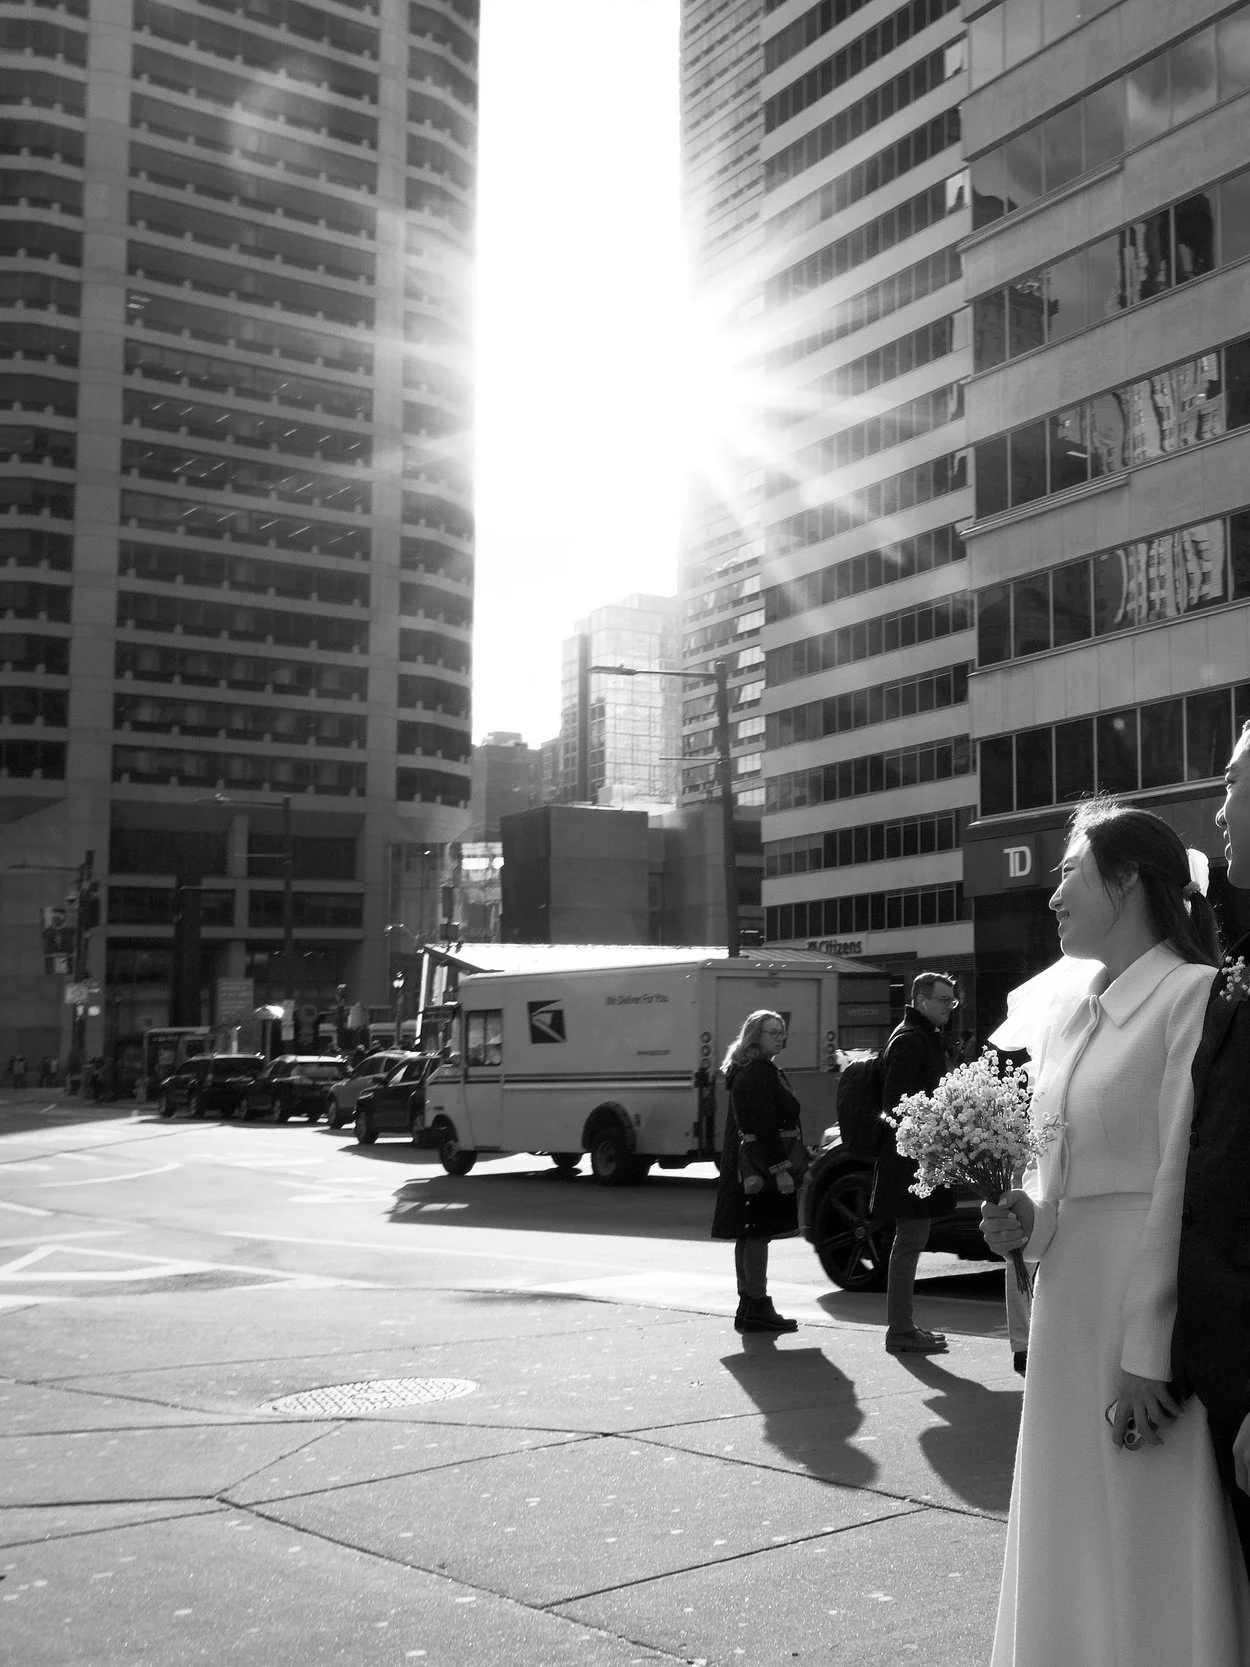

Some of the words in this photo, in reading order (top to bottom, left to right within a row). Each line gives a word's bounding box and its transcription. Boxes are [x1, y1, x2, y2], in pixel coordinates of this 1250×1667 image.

[1003, 845, 1032, 878] TD
[819, 939, 862, 956] Citizens
[606, 997, 617, 1006] We
[618, 995, 641, 1005] Deliver
[643, 994, 654, 1004] For
[655, 993, 669, 1003] You
